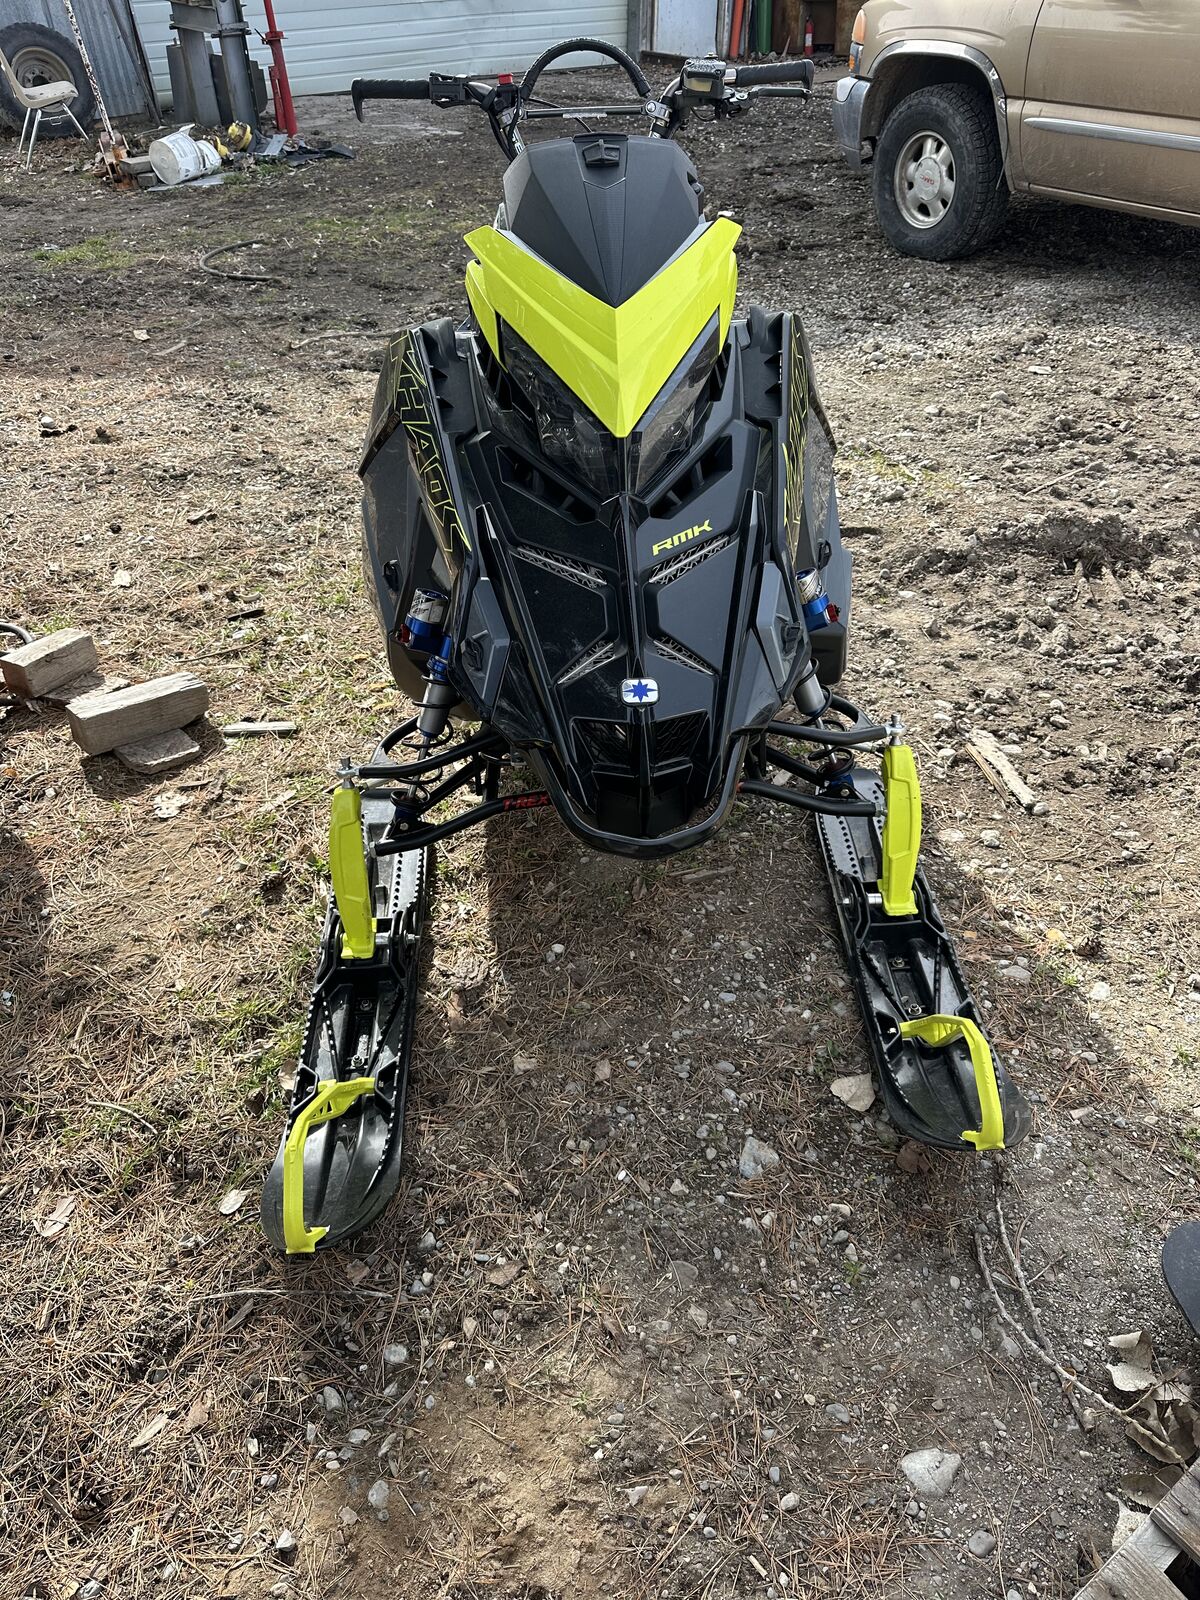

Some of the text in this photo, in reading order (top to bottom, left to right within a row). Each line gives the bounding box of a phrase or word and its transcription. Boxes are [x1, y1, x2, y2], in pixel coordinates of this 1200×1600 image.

[919, 175, 935, 186] GMC
[390, 329, 472, 552] KHAOS
[652, 519, 712, 556] RMK
